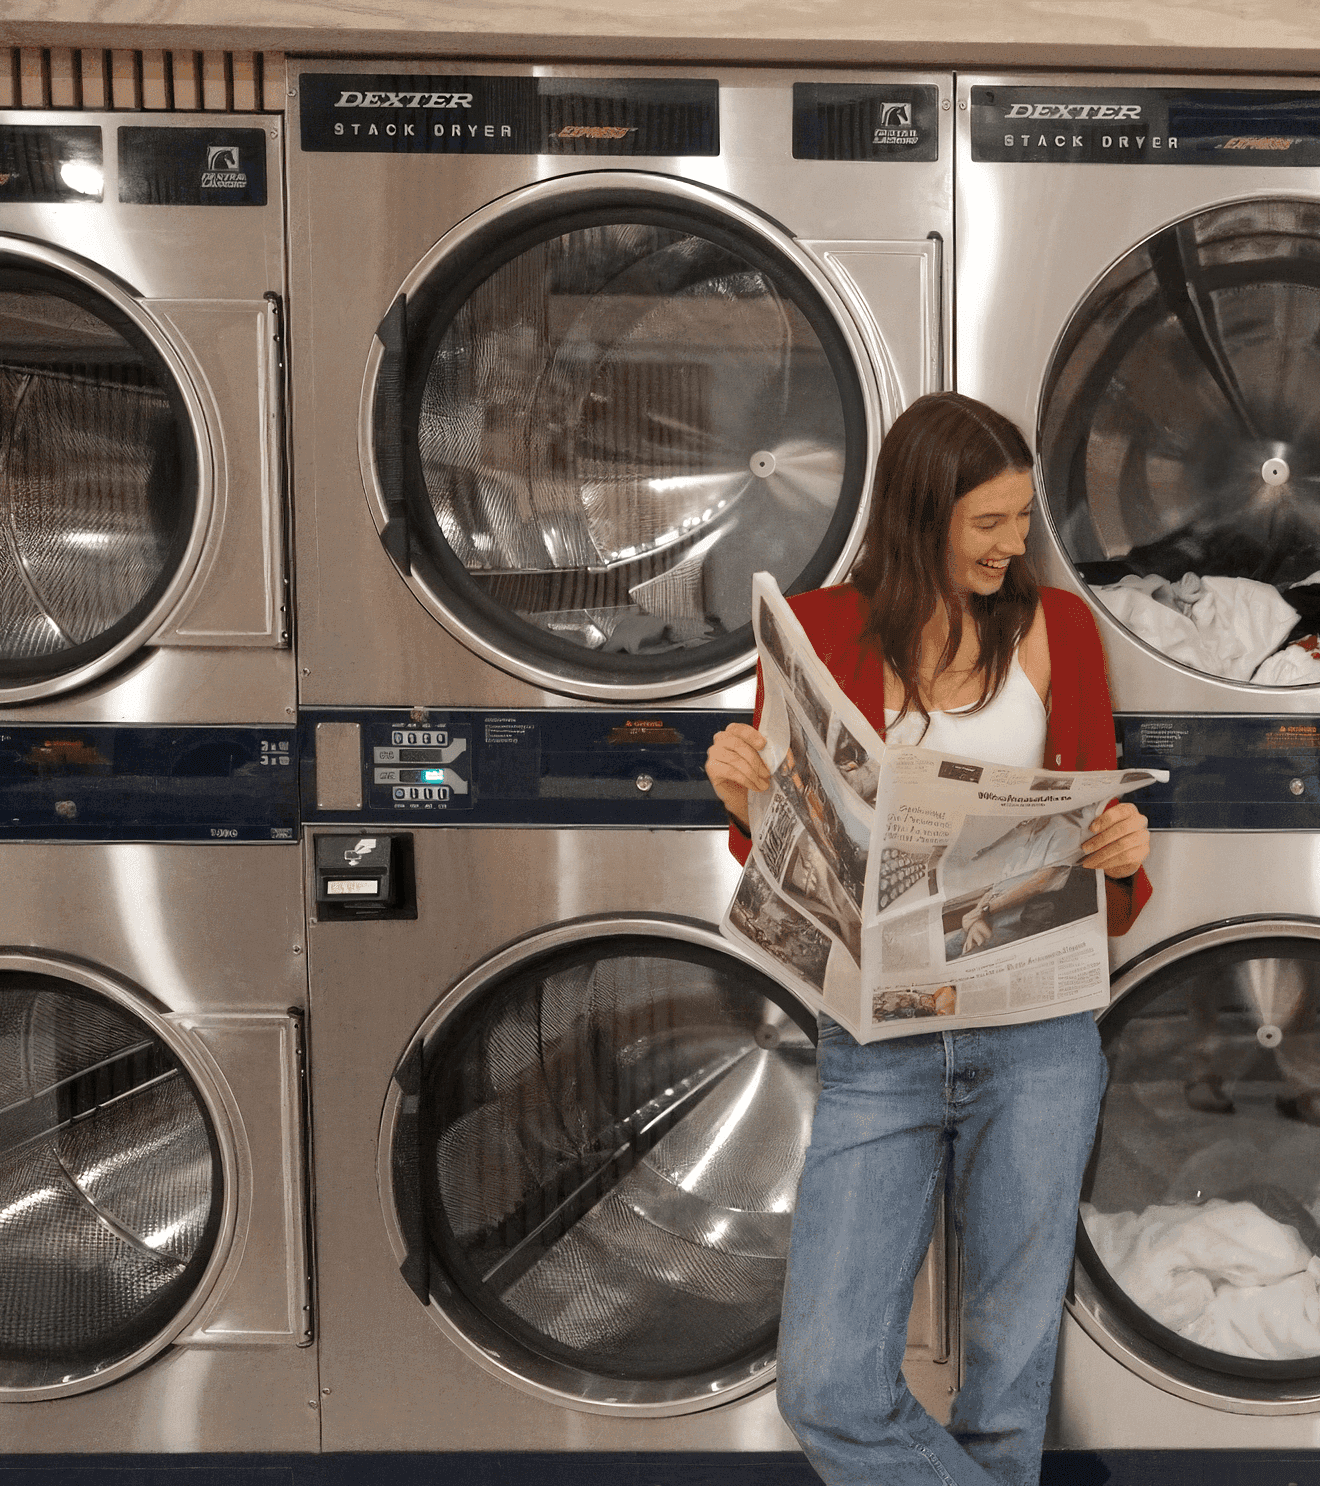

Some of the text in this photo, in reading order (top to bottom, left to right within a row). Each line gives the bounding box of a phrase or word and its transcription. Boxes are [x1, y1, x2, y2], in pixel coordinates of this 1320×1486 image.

[334, 91, 473, 108] DEXTER
[1004, 103, 1142, 120] DEXTER
[1004, 134, 1179, 149] STACK DRYER
